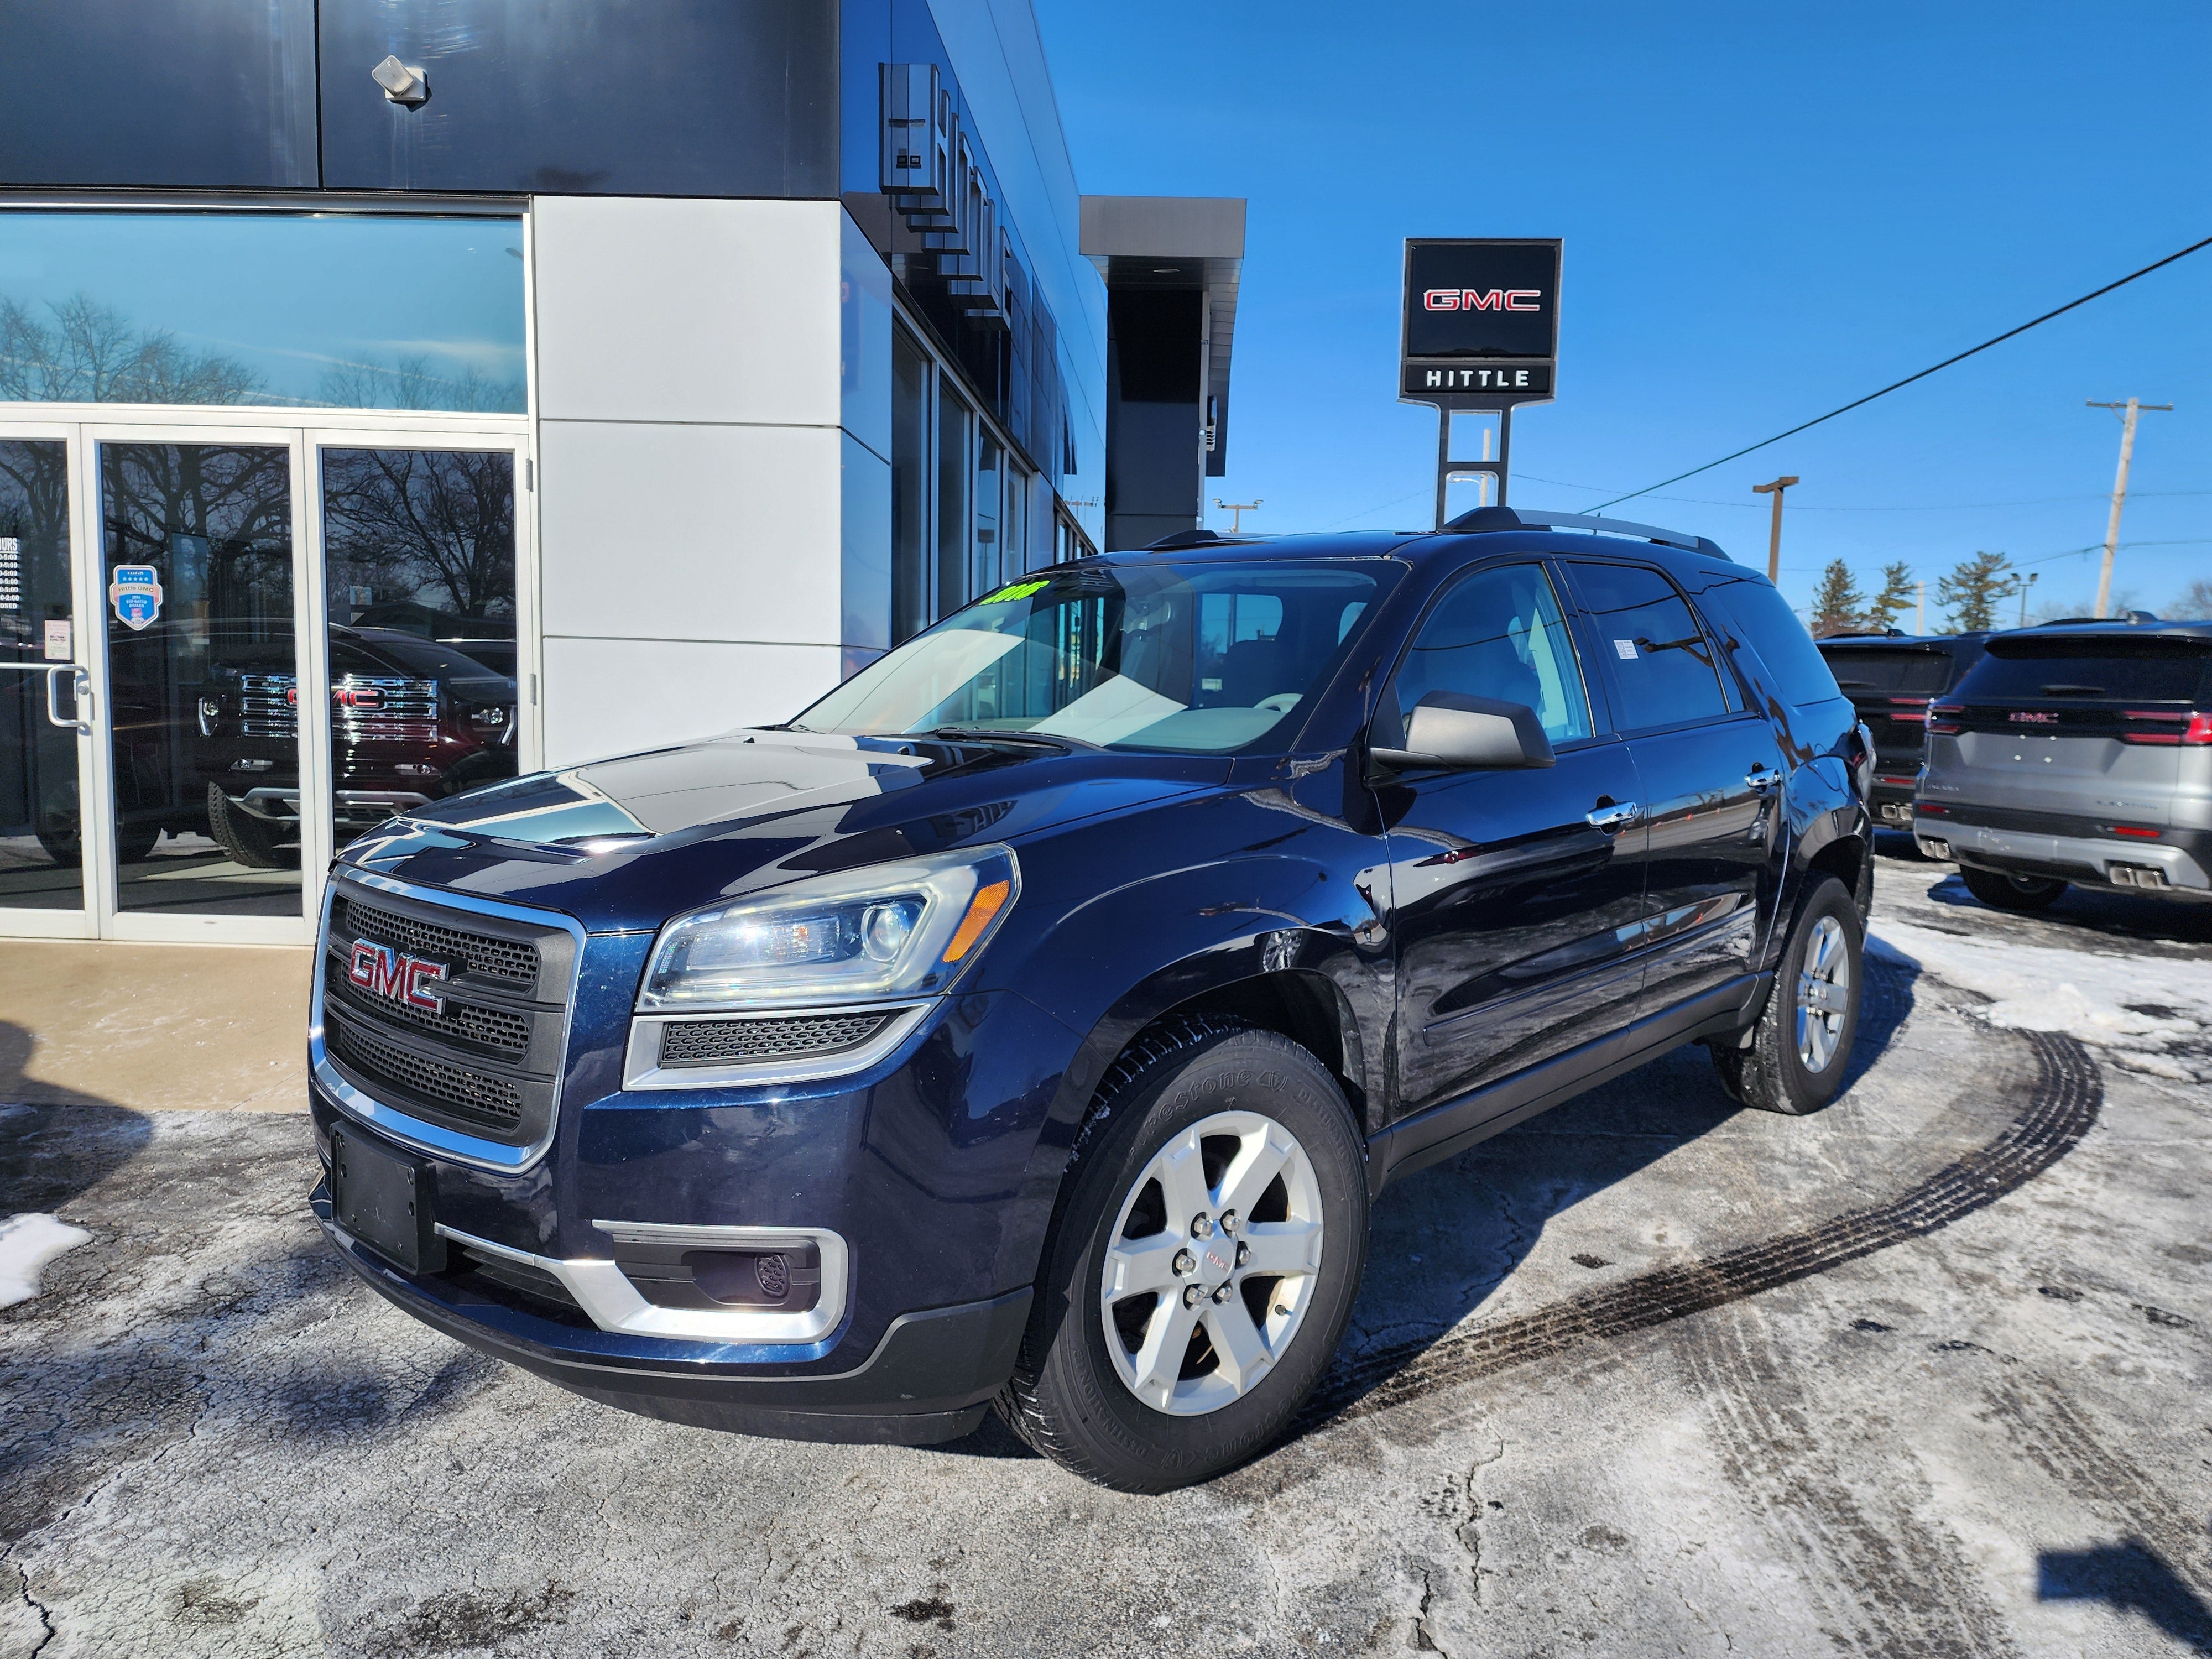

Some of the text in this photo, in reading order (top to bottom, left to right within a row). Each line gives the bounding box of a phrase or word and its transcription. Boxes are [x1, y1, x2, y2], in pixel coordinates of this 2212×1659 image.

[1423, 289, 1541, 311] GMC
[1426, 370, 1530, 387] HITTLE
[0, 537, 18, 551] URS
[2009, 712, 2059, 724] GMC
[349, 938, 451, 1014] GMC
[1206, 1251, 1230, 1272] GMC
